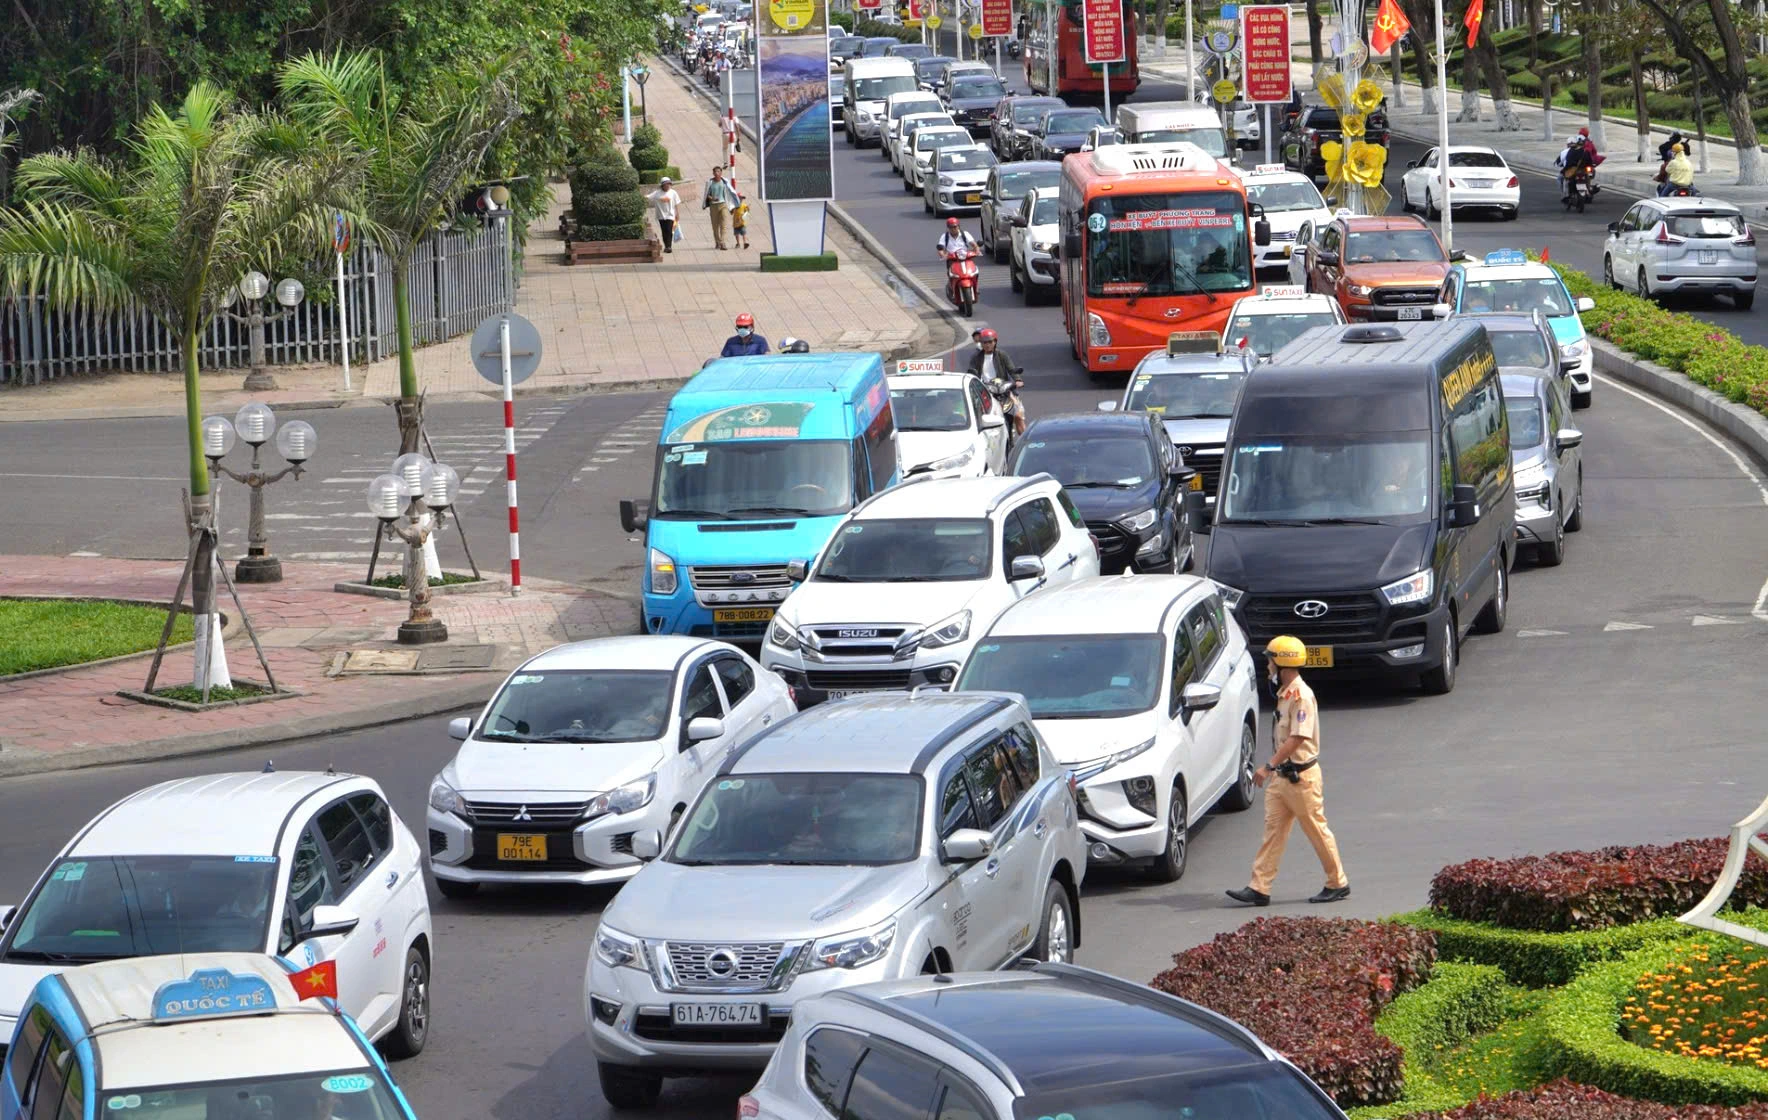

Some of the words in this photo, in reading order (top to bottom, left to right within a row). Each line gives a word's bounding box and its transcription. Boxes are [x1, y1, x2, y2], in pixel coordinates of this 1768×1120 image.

[1268, 25, 1281, 34] CÔNG
[1089, 216, 1105, 229] 05-2
[1198, 218, 1232, 226] VINPEARL
[838, 629, 878, 638] ISUZU
[512, 836, 533, 847] 79E
[503, 848, 541, 858] 001.14
[200, 976, 229, 990] TAXI
[165, 992, 231, 1014] QUỐC
[236, 987, 267, 1007] TẾ
[677, 1006, 758, 1022] 61A-764.74
